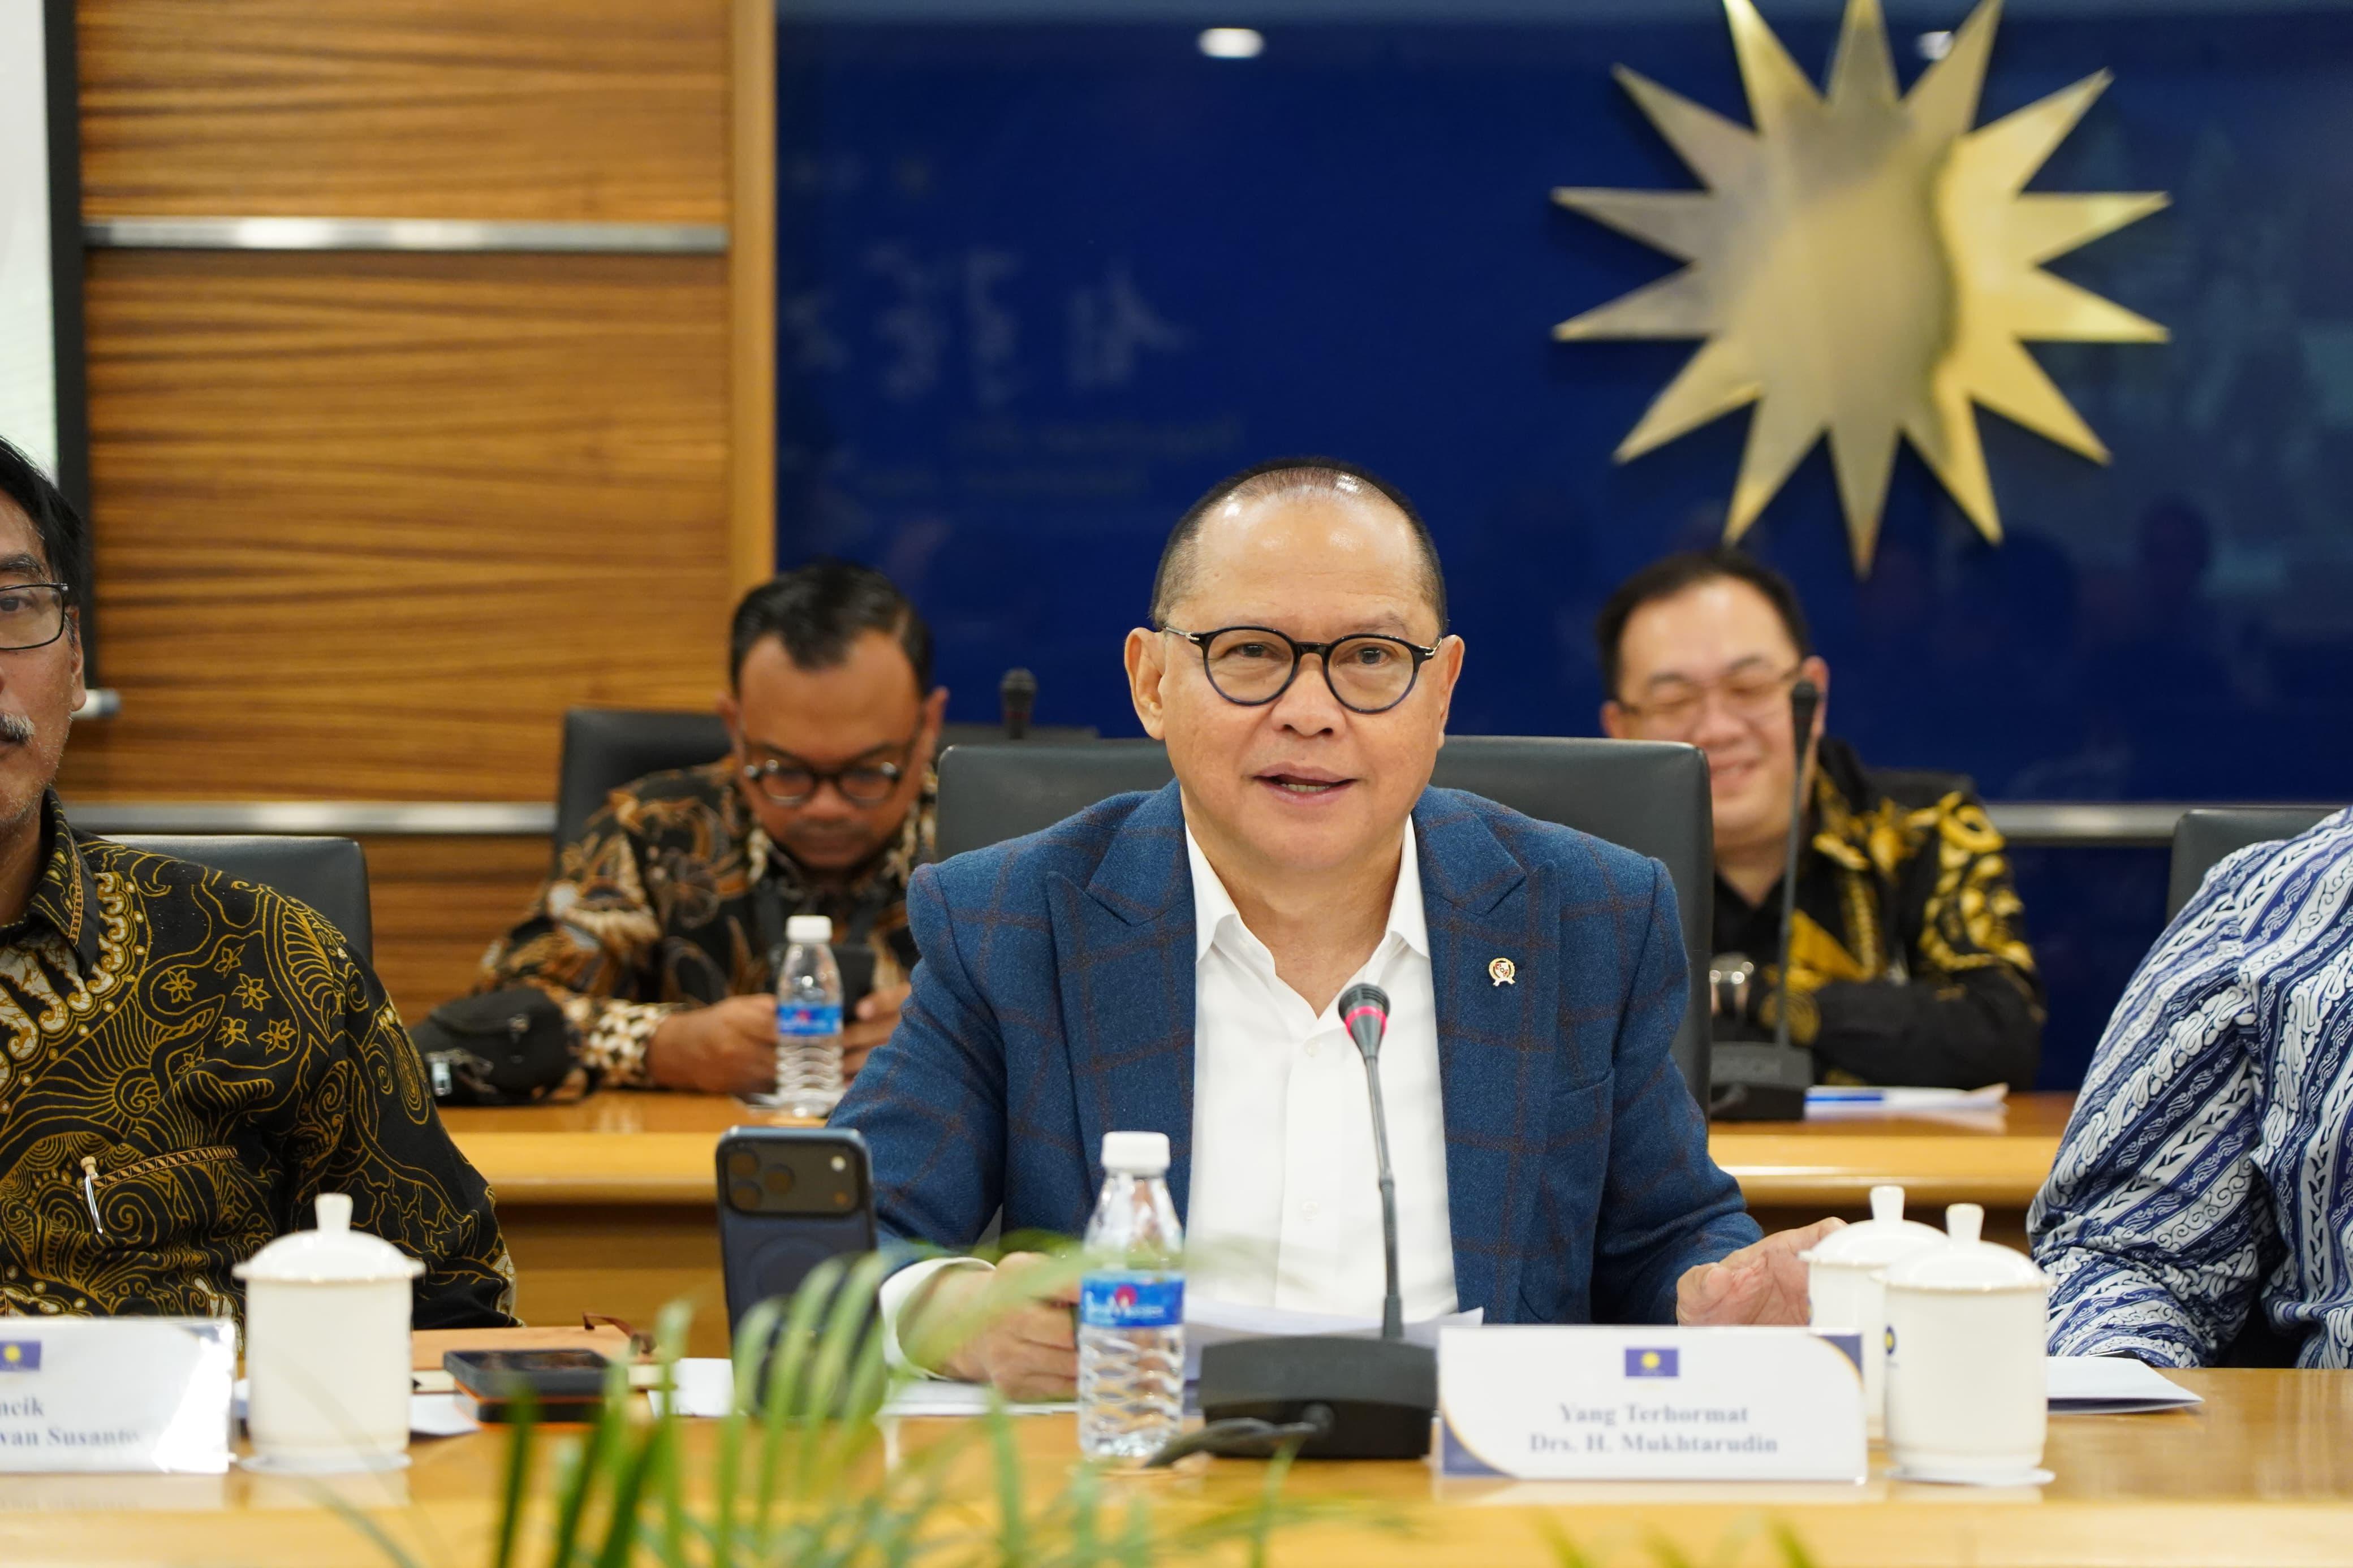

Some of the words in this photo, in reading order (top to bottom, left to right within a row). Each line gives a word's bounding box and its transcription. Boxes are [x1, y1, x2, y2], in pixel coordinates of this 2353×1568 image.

[1559, 1402, 1617, 1426] Yang
[1626, 1402, 1748, 1423] Terhormat
[1529, 1432, 1577, 1452] Drs.
[1585, 1432, 1613, 1452] H.
[1621, 1431, 1778, 1452] Mukhtarudin
